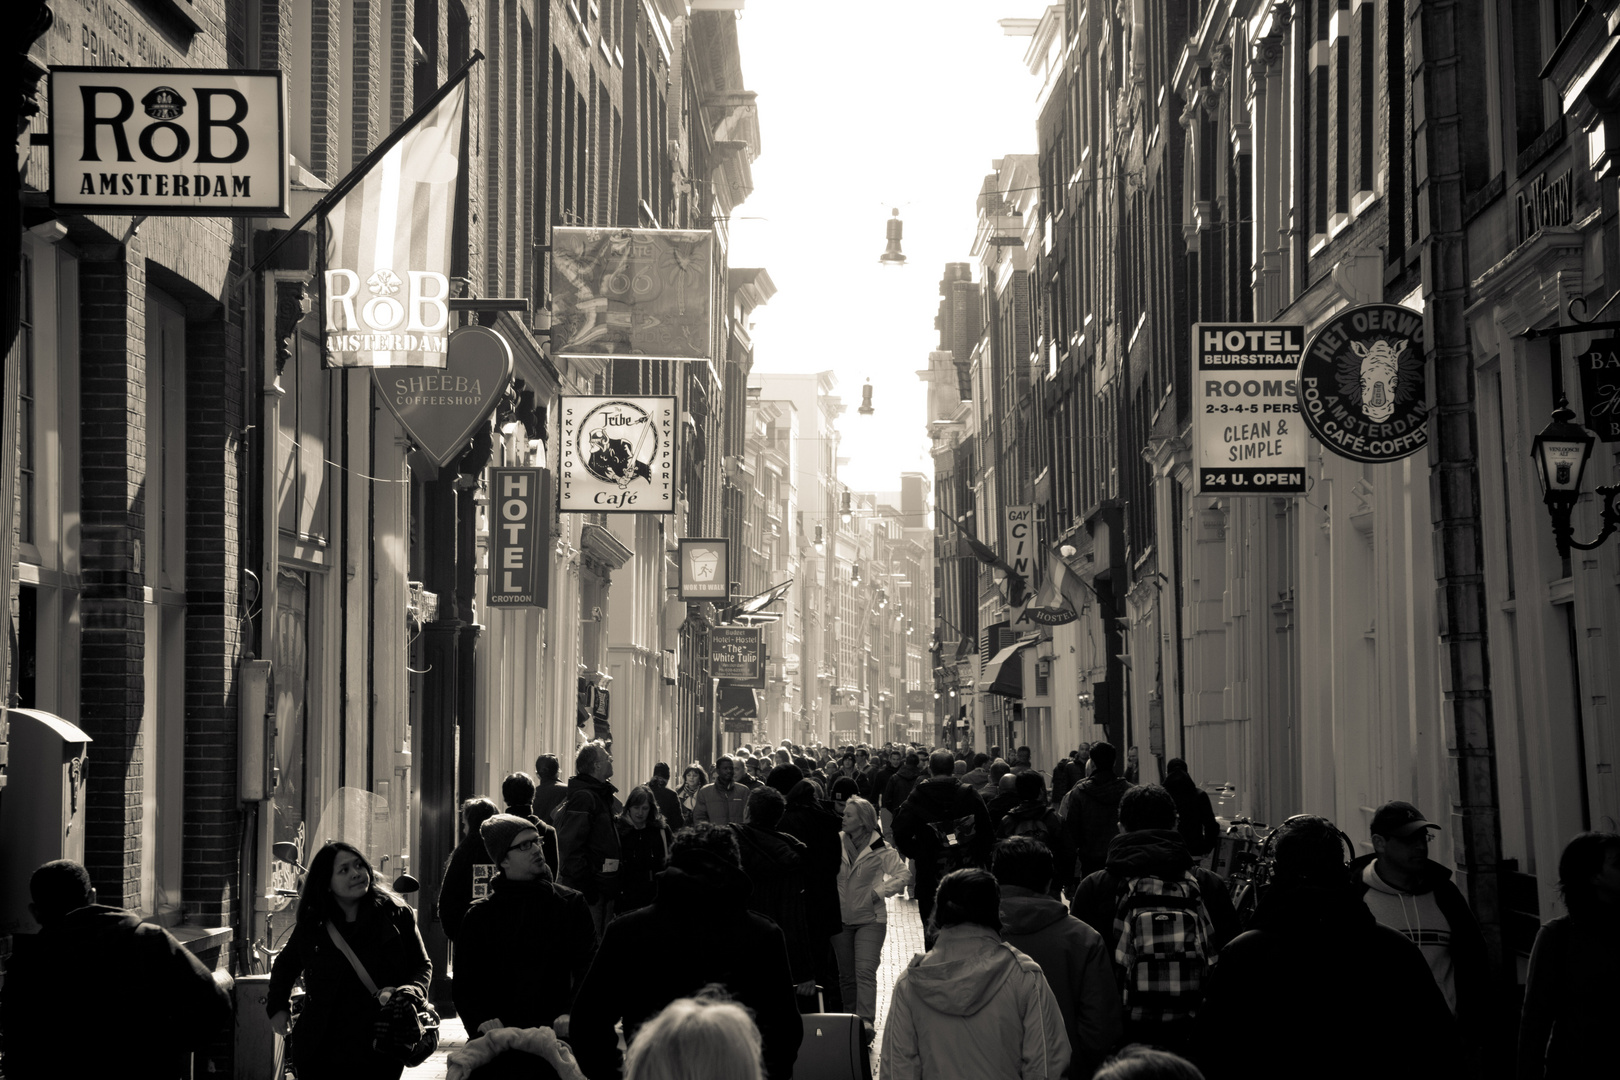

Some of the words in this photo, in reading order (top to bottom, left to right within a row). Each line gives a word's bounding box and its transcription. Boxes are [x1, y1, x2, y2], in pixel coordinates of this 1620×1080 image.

[79, 172, 252, 198] AMSTERDAM
[325, 334, 448, 353] AMSTERDAM
[1204, 330, 1300, 352] HOTEL
[1312, 322, 1349, 363] HET
[1204, 353, 1300, 365] BEURSSTRAAT
[395, 375, 482, 396] SHEEBA
[1205, 379, 1298, 398] ROOMS
[396, 396, 482, 406] COFFEESHOP
[1205, 403, 1259, 414] 2-3-4-5
[1303, 377, 1326, 424] POOL
[599, 411, 634, 428] Tribe
[1324, 395, 1428, 438] AMSTERDAM
[1223, 420, 1271, 443] CLEAN
[1276, 419, 1288, 436] &
[564, 408, 574, 500] SKYSPORTS
[662, 408, 672, 501] SKYSPORTS
[1228, 439, 1283, 462] SIMPLE
[1205, 473, 1226, 486] 24
[1231, 473, 1249, 486] U.
[1255, 473, 1301, 486] OPEN
[593, 490, 638, 509] Café
[1008, 510, 1030, 521] GAY
[502, 475, 528, 593] HOTEL
[1011, 523, 1032, 625] CINA
[491, 595, 532, 603] CROYDON
[1036, 610, 1076, 622] HOSTEL
[712, 652, 735, 663] White
[737, 653, 757, 663] Tulip
